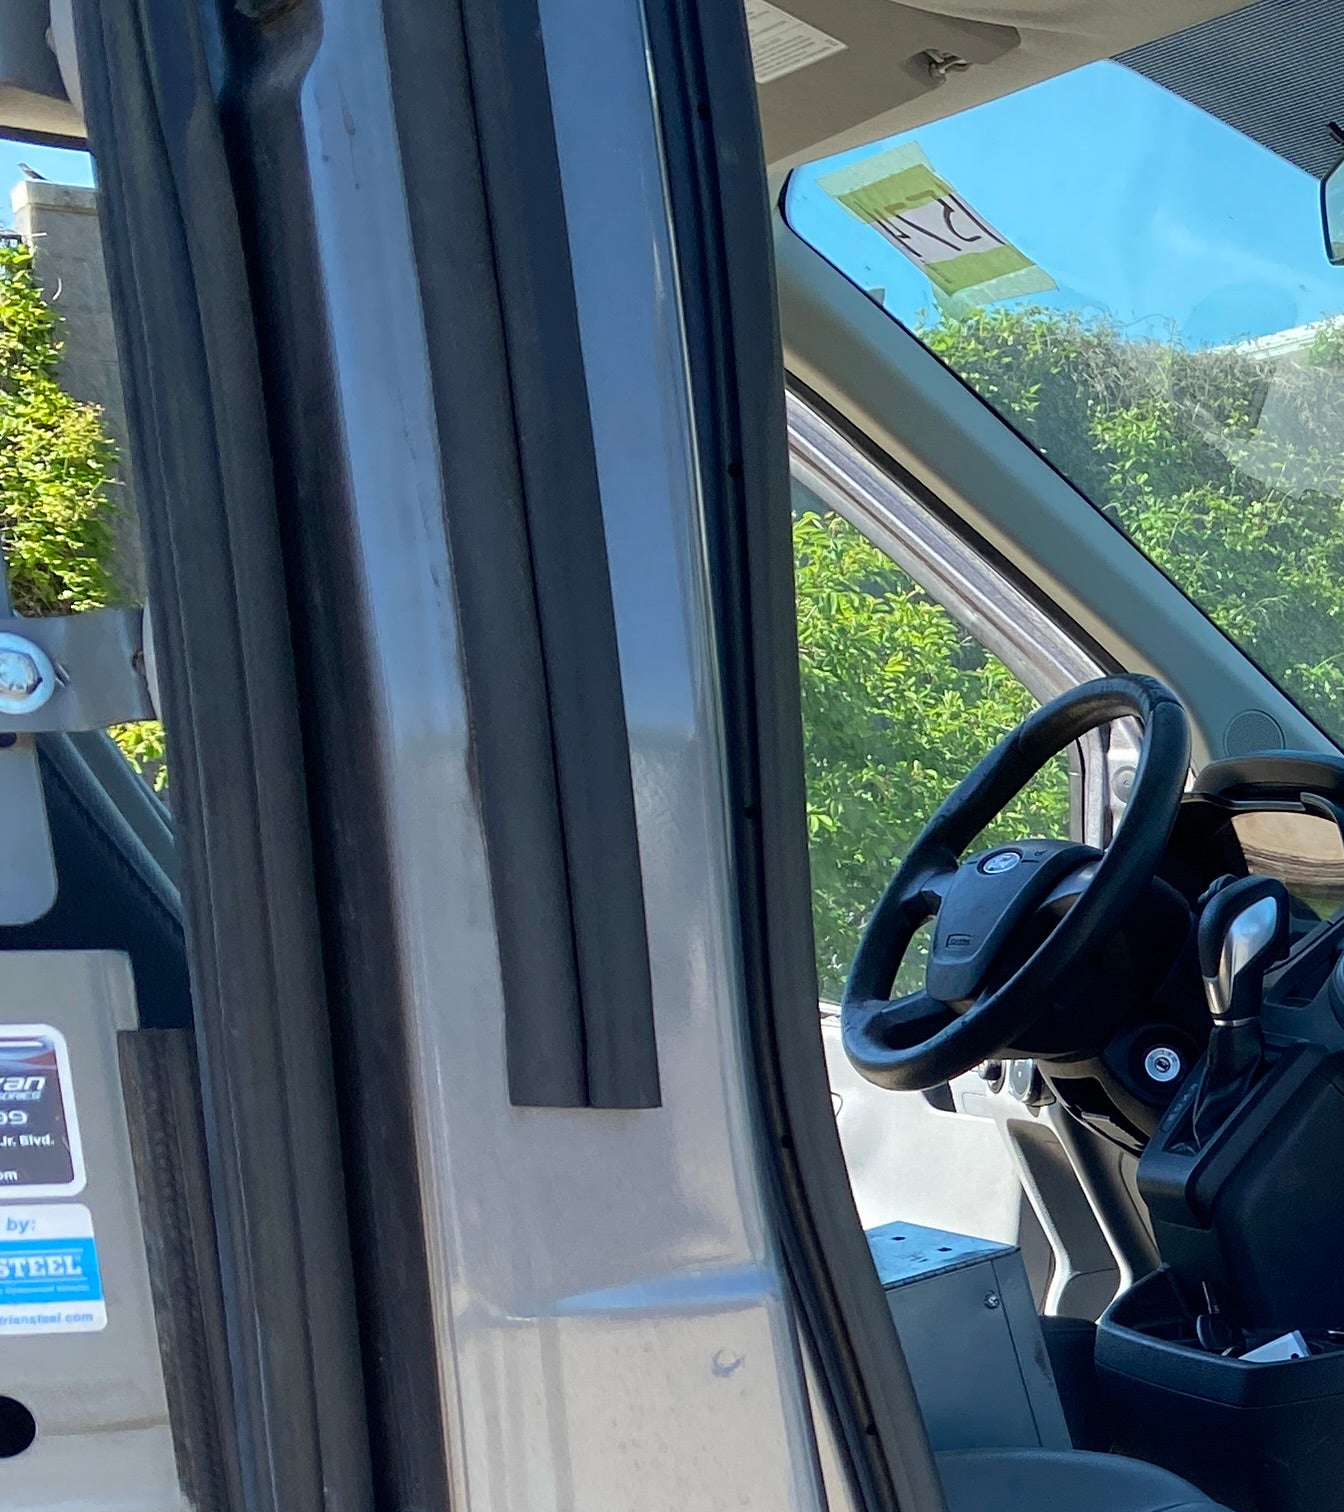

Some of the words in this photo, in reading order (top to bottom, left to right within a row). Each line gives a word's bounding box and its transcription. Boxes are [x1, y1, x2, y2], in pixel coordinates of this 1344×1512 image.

[19, 1134, 54, 1146] Blvd.
[6, 1217, 37, 1234] by:
[0, 1312, 93, 1326] riansteel.com
